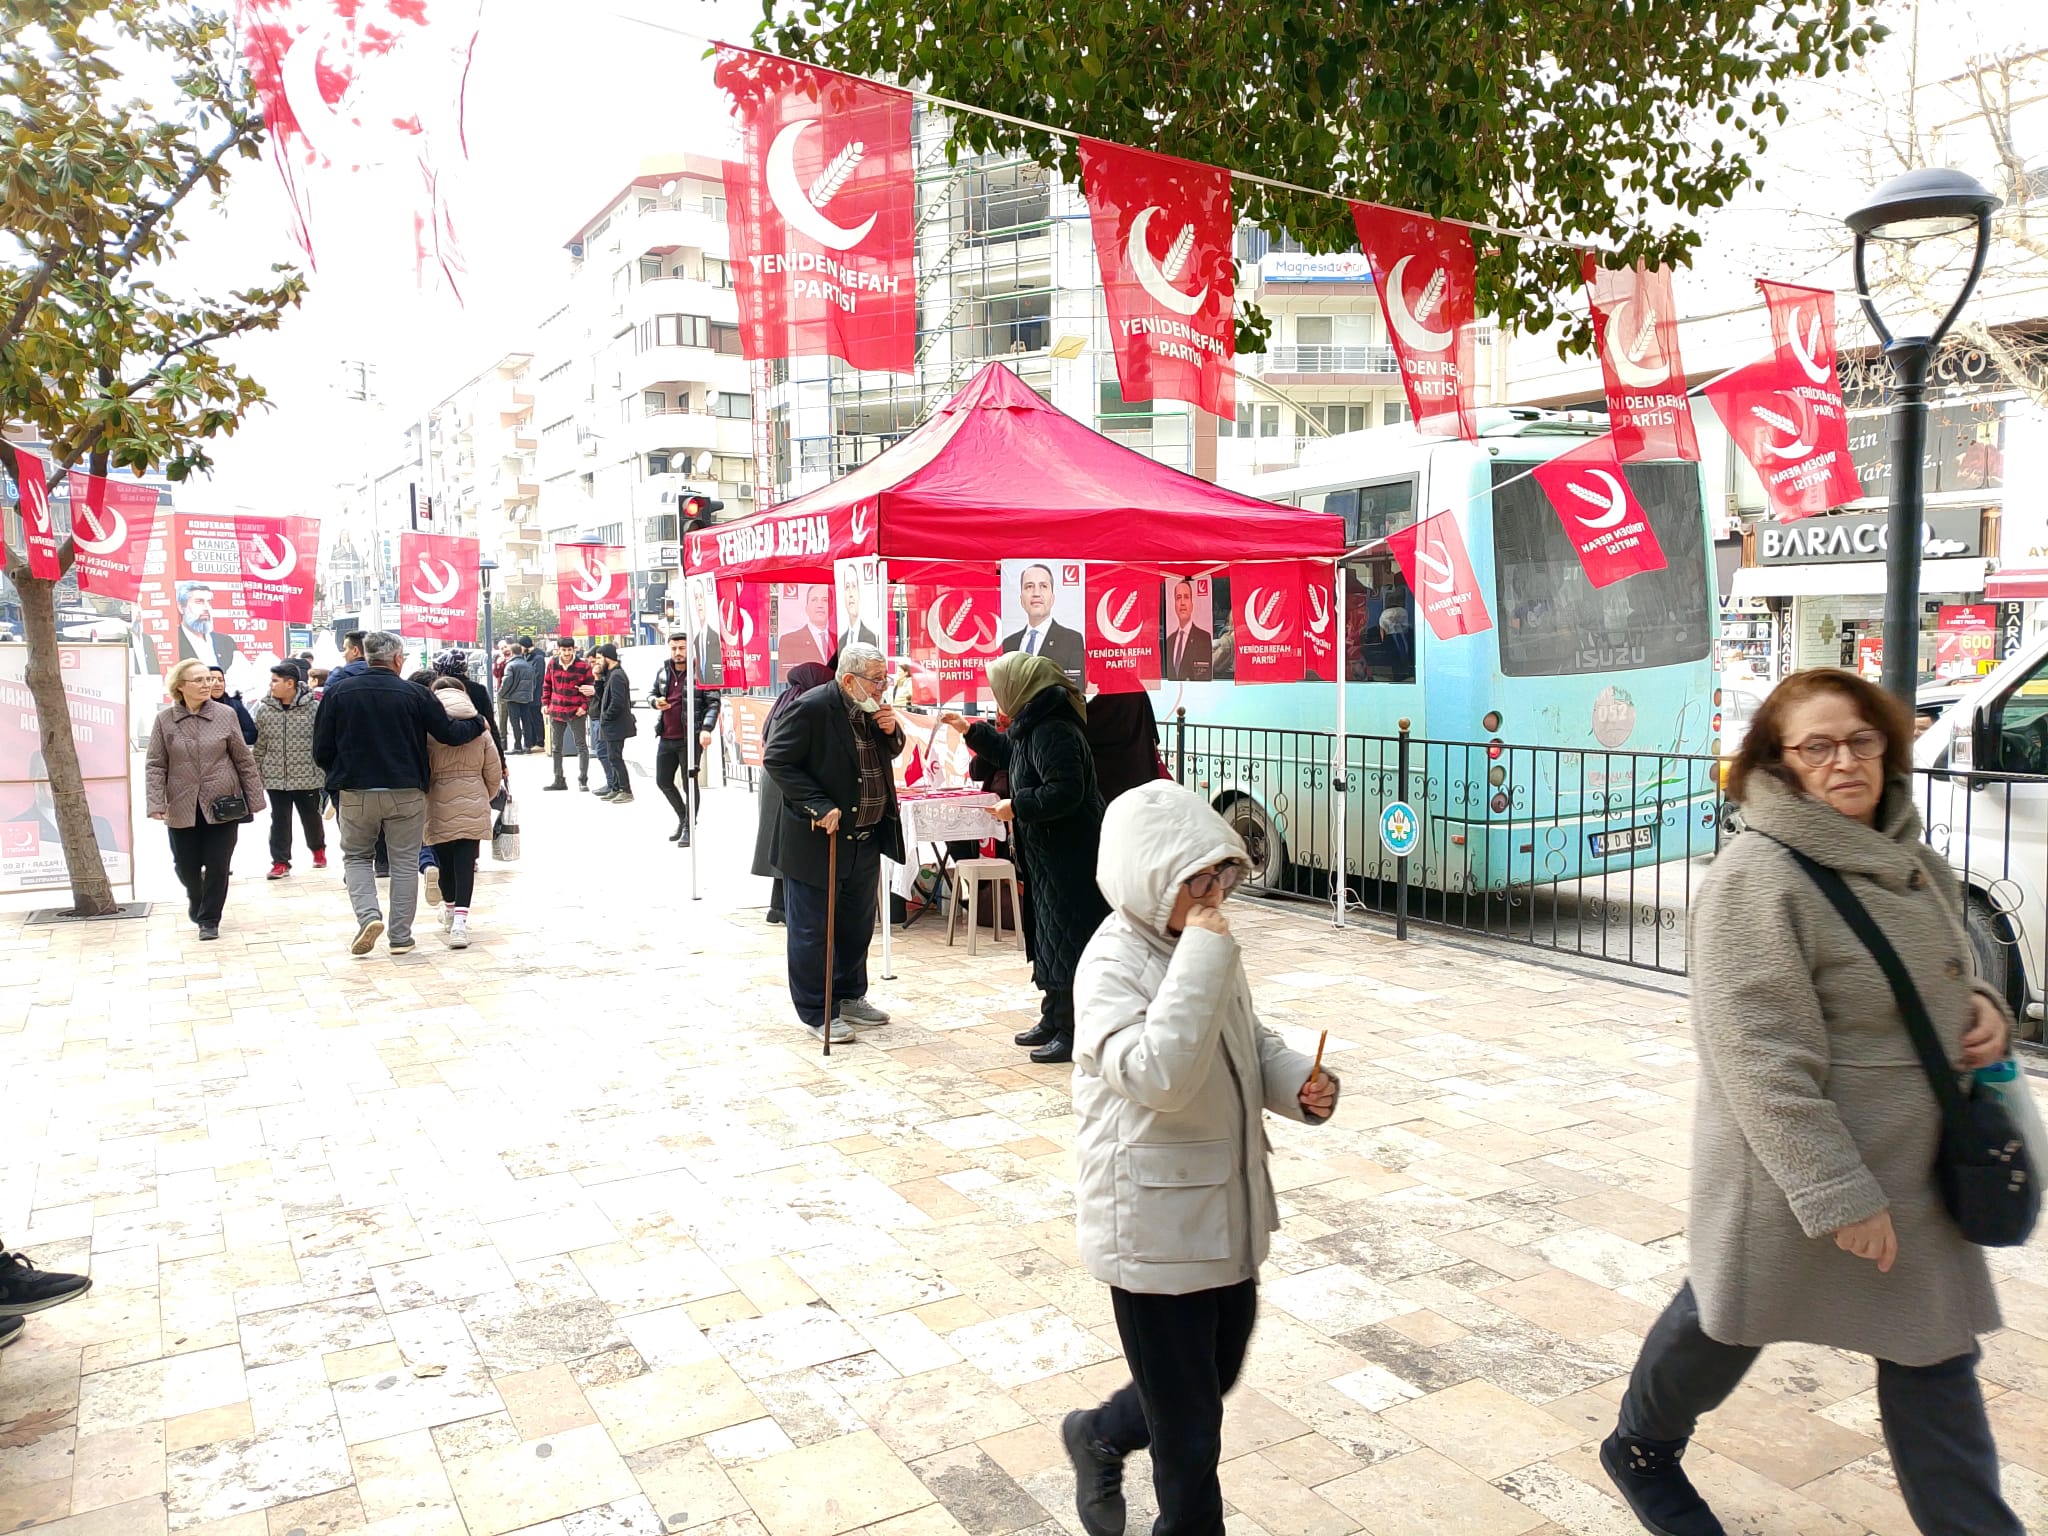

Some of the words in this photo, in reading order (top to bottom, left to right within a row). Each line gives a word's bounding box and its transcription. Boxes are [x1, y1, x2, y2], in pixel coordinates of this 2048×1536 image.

[749, 248, 838, 278] YENİDEN
[839, 265, 899, 294] REFAH
[1276, 260, 1335, 275] Magnesia
[794, 280, 856, 313] PARTİSİ
[1120, 315, 1190, 340] YENİDEN
[1190, 328, 1224, 356] REFAH
[1408, 379, 1458, 396] PARTİSİ
[232, 618, 267, 631] 19:30
[1962, 635, 1992, 649] 600
[1088, 646, 1126, 658] YENİDEN
[1128, 647, 1152, 657] REFAH
[1575, 646, 1646, 668] ISUZU
[920, 656, 961, 669] YENİDEN
[1106, 657, 1137, 669] PARTİSİ
[940, 670, 974, 681] PARTİSİ
[1597, 703, 1629, 722] 052
[1614, 834, 1621, 847] D
